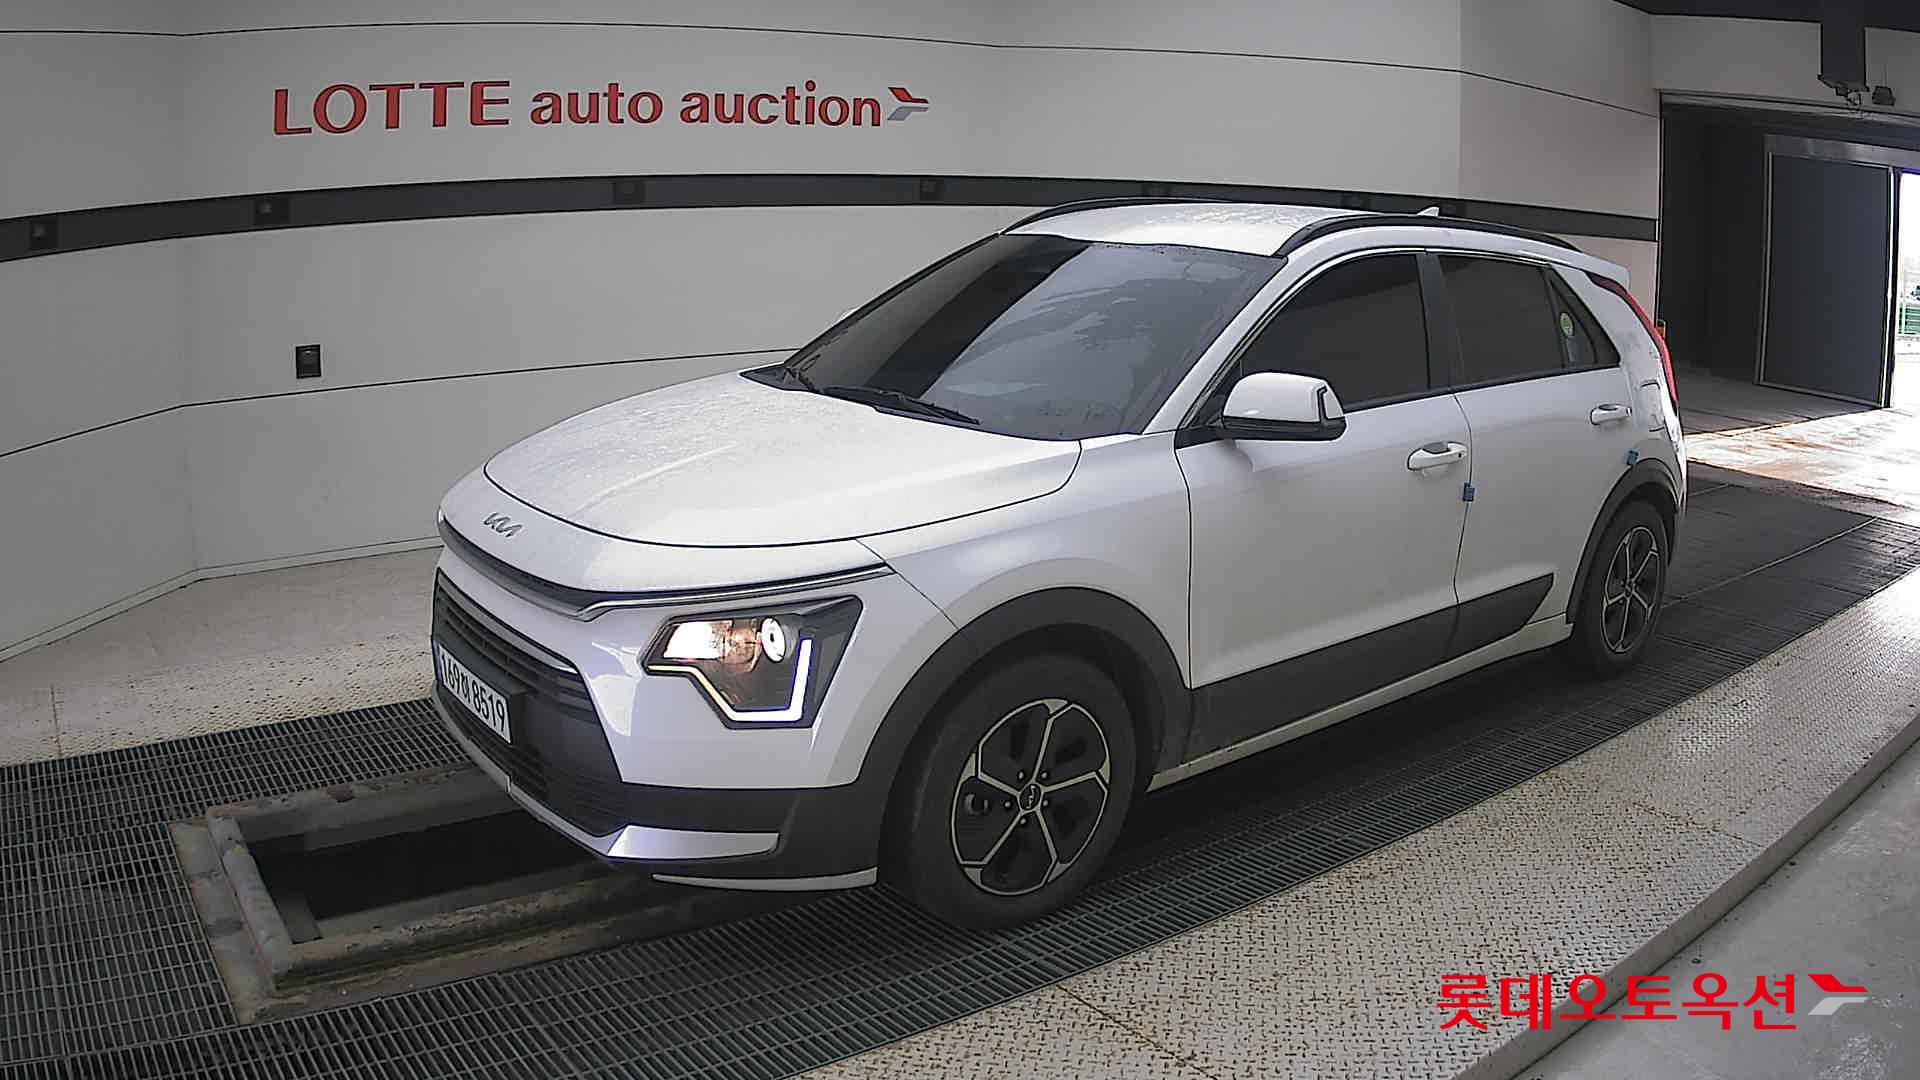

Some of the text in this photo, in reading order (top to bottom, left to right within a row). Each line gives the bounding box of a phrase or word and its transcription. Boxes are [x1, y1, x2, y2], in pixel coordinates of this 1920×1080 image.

[273, 80, 882, 136] LOTTE auto auction
[471, 679, 506, 732] 8519
